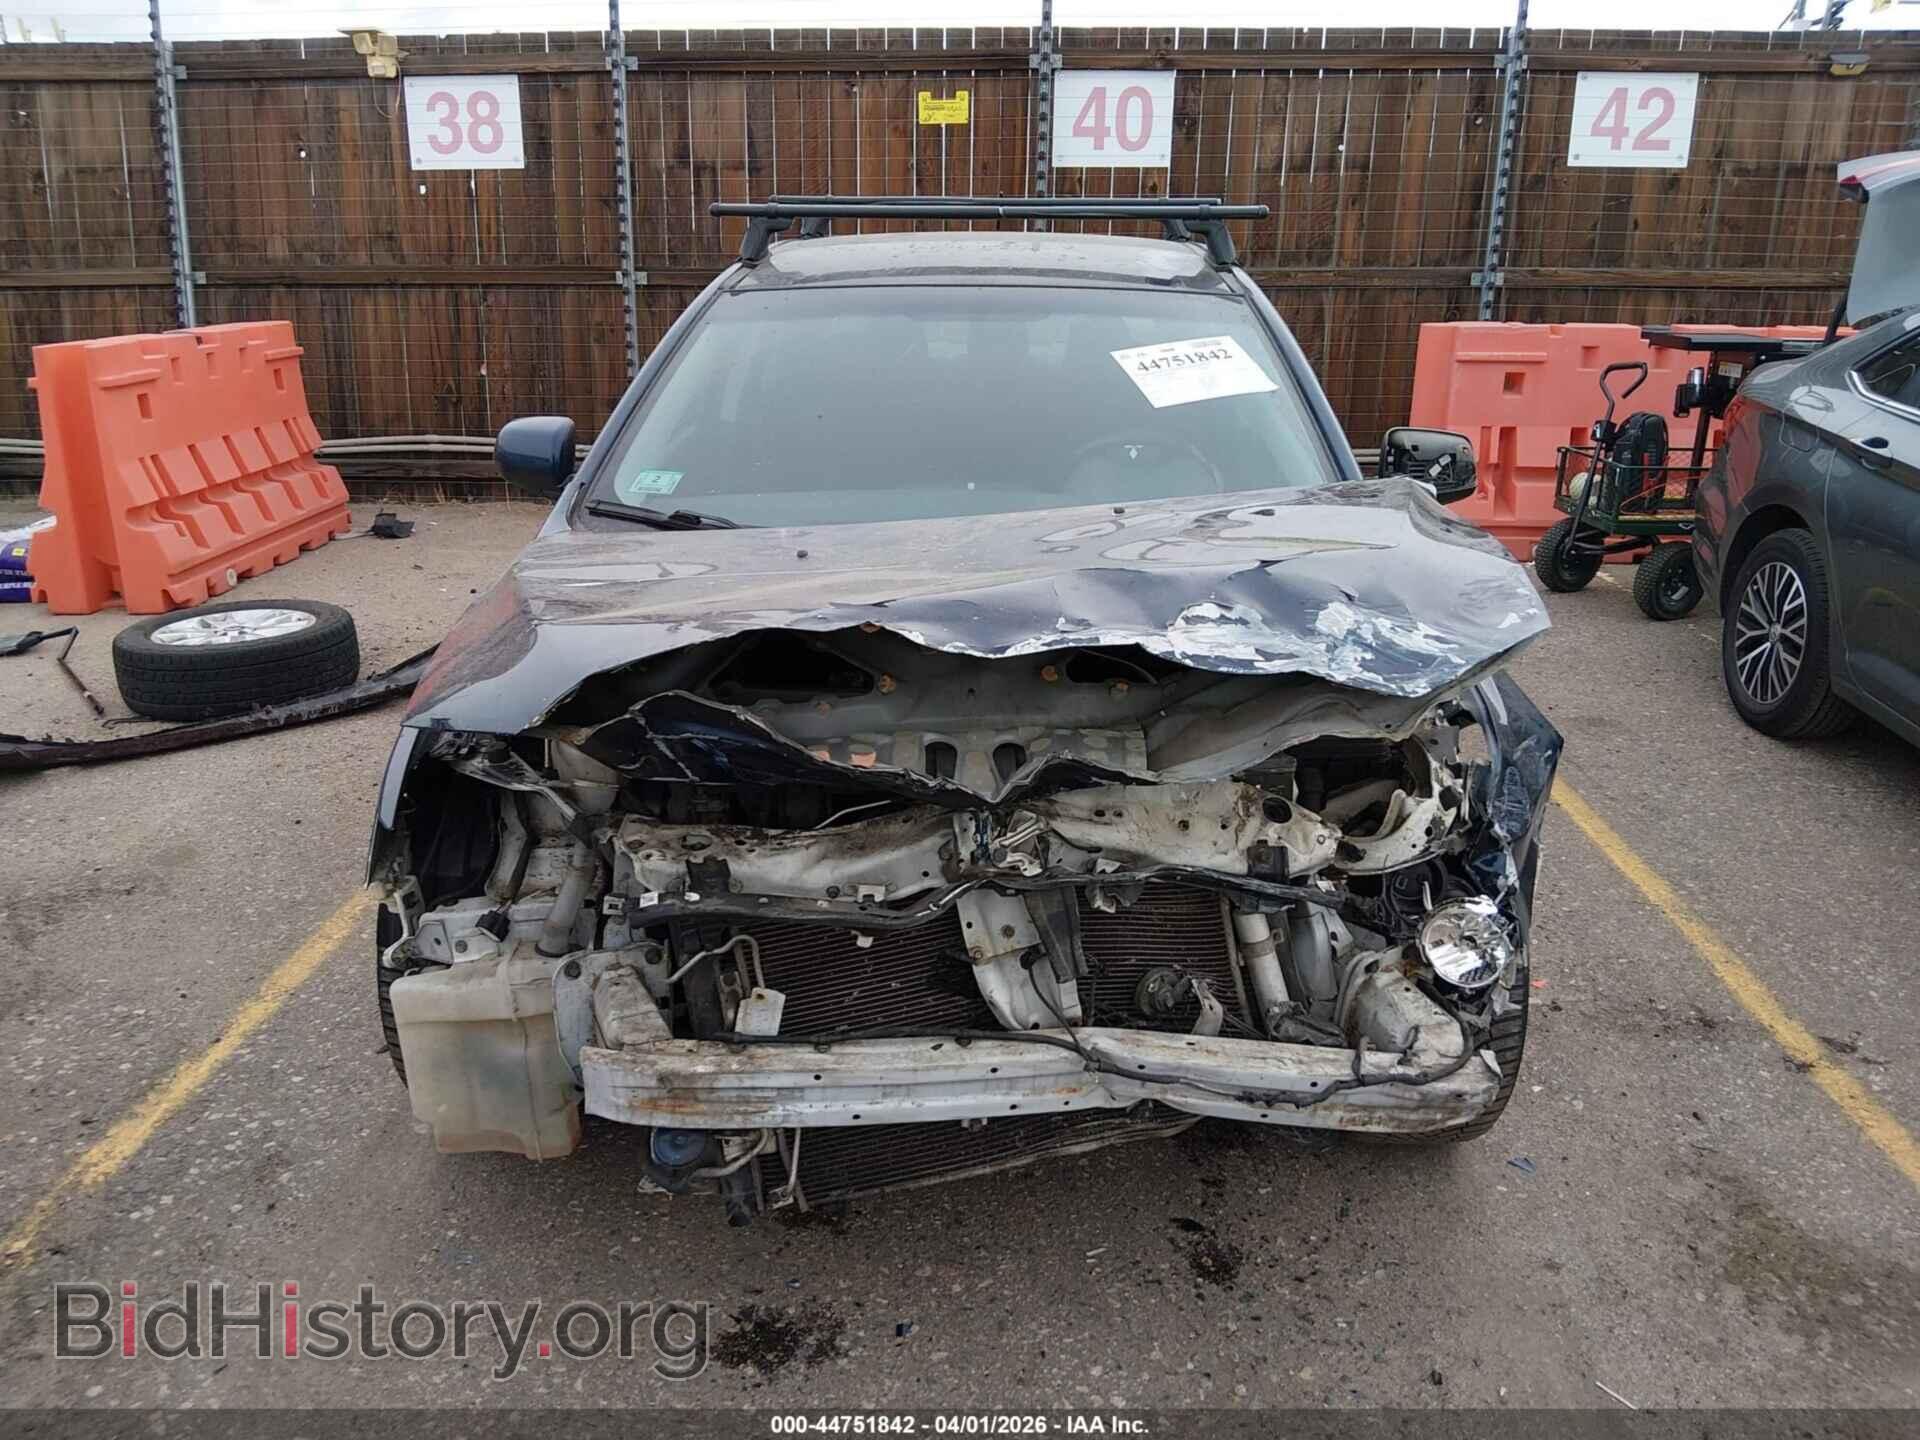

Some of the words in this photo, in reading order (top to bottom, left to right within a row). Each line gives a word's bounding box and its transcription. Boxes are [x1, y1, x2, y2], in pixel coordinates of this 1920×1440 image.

[426, 90, 504, 155] 38
[1072, 86, 1153, 151] 40
[1590, 87, 1675, 151] 42
[1136, 348, 1233, 372] 44751842
